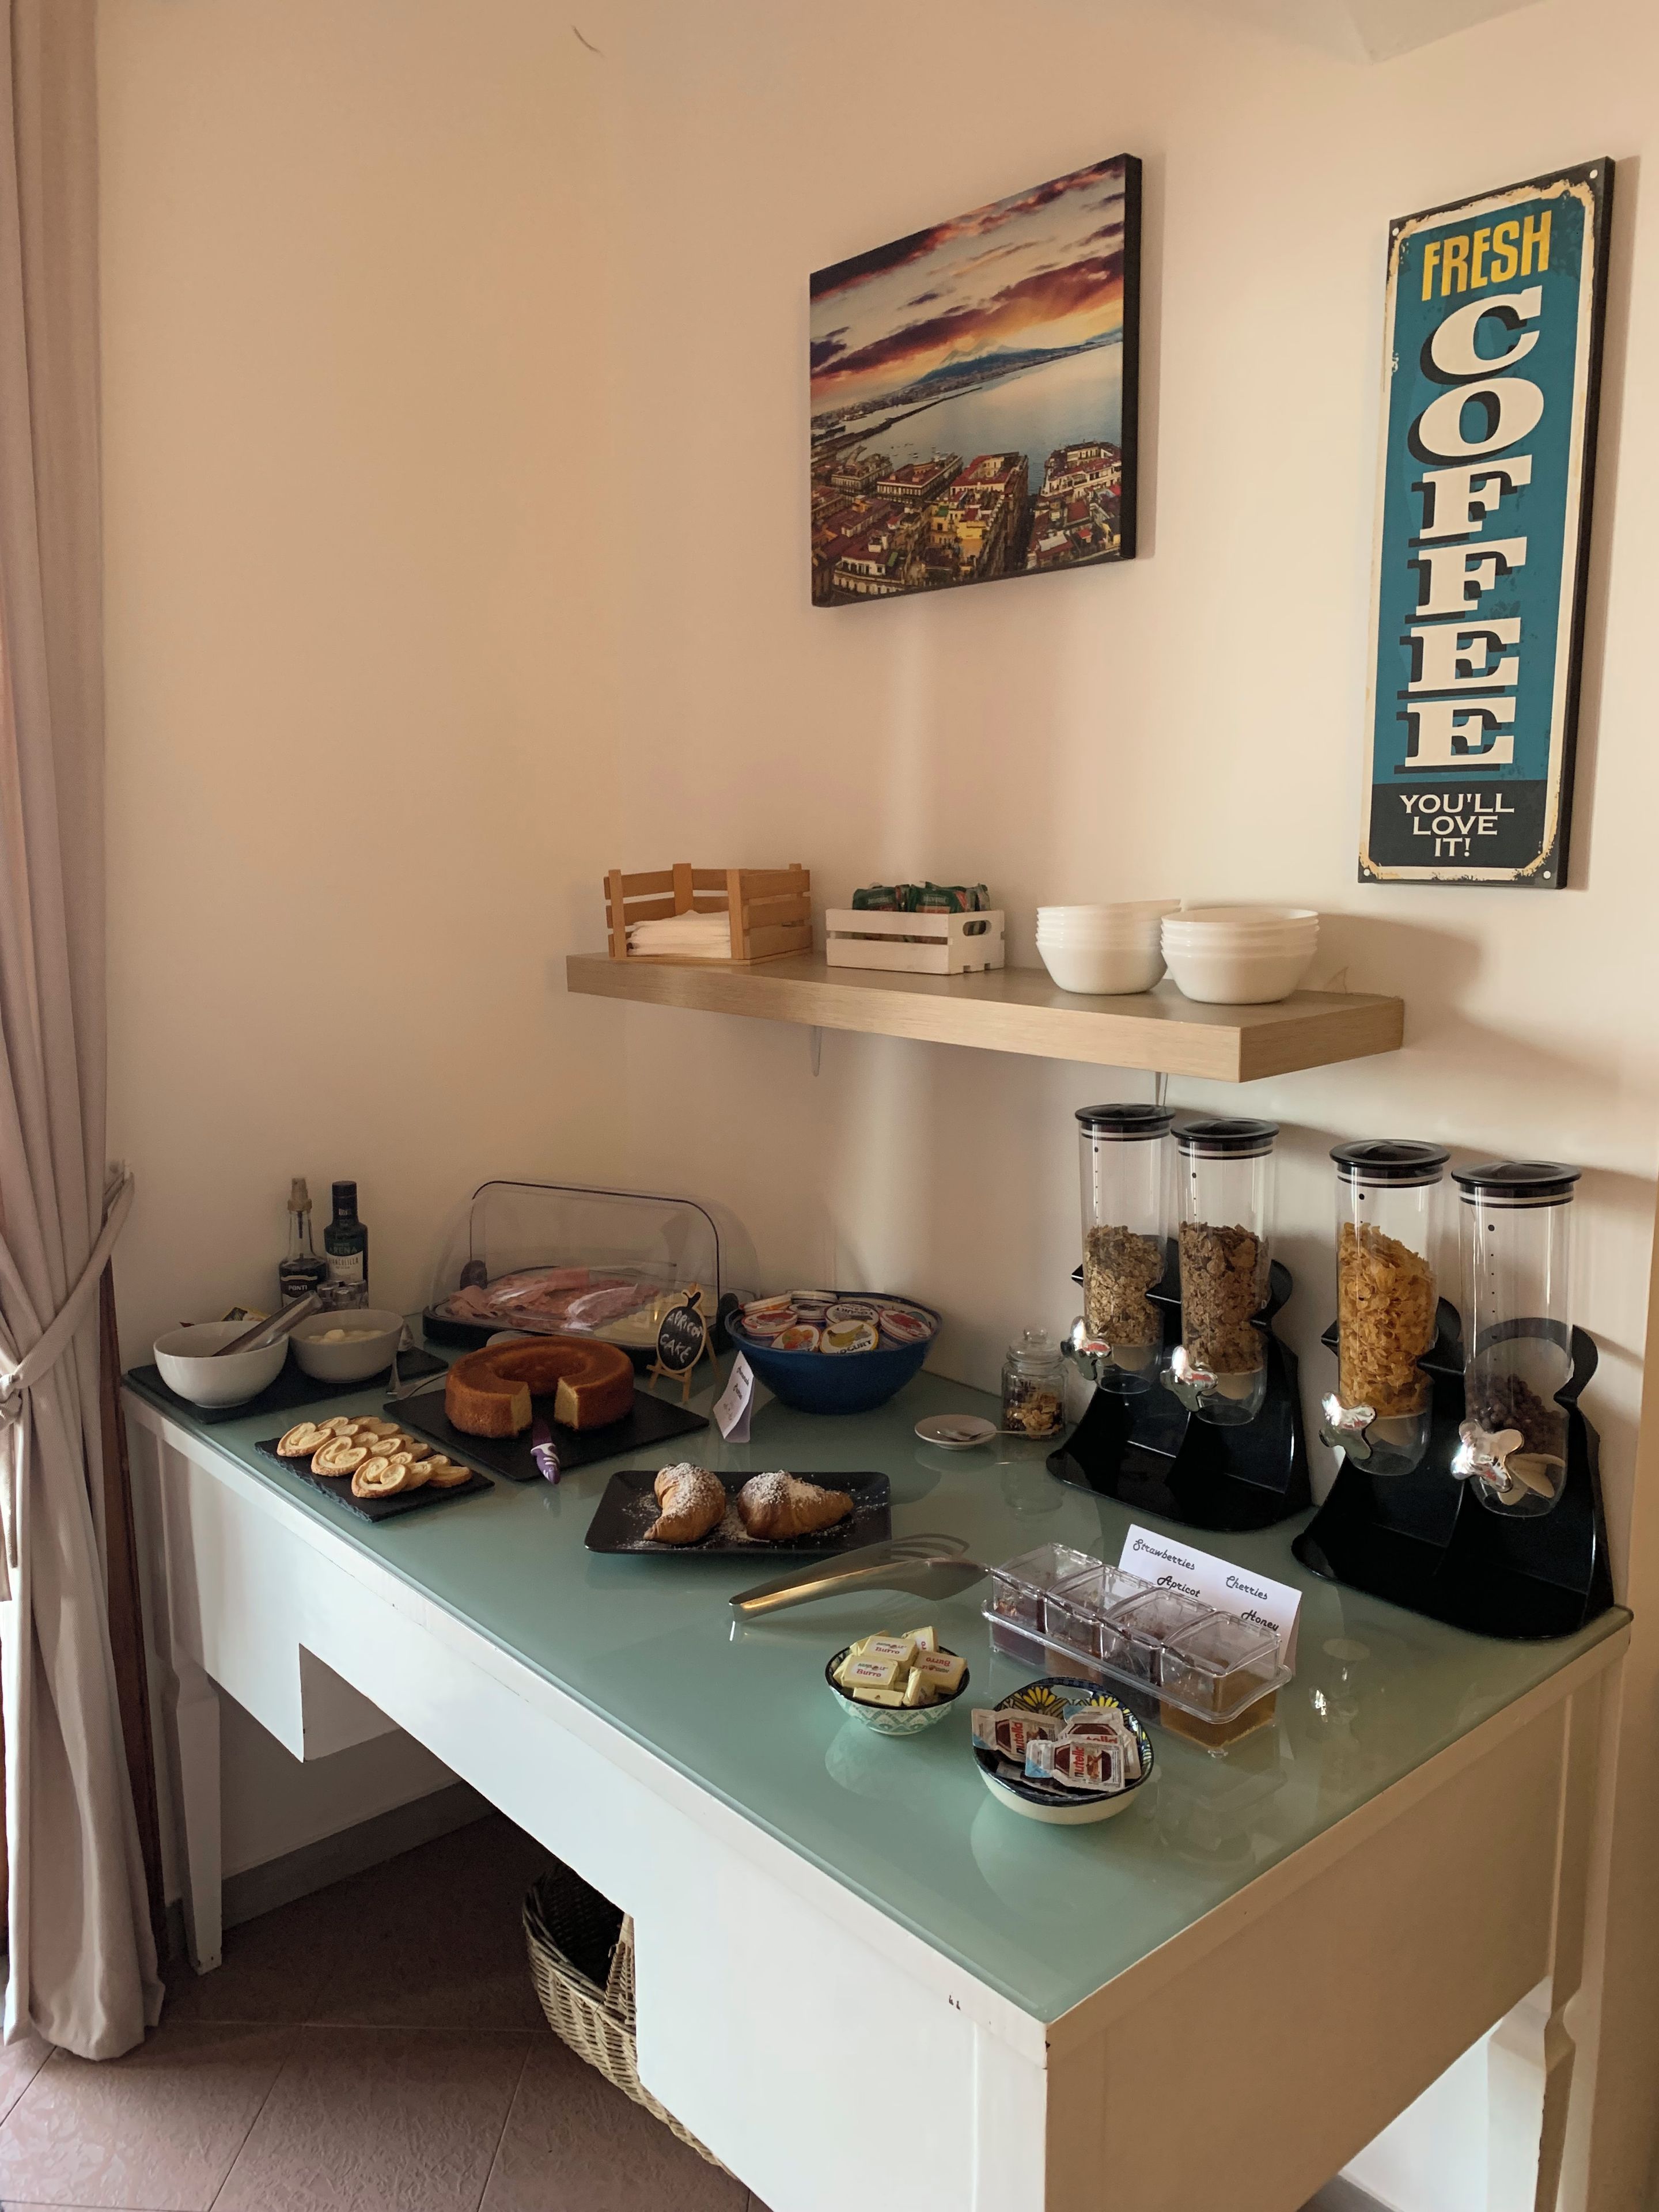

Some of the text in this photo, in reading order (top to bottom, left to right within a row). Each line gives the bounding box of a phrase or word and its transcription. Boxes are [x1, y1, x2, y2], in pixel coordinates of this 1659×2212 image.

[1421, 210, 1552, 301] FRESH
[1399, 285, 1545, 771] COFFEE
[1399, 793, 1515, 814] YOU'LL
[1412, 815, 1498, 836] LOVE
[1434, 837, 1471, 858] IT!
[328, 1246, 358, 1255] ARENA
[660, 1333, 692, 1363] CAKE
[836, 1339, 872, 1354] OGURT
[1132, 1539, 1195, 1570] Strawberries
[1157, 1575, 1201, 1598] Apricot
[1226, 1575, 1268, 1600] Cherries
[1241, 1609, 1279, 1632] Honey
[875, 1646, 900, 1655] Burro
[925, 1657, 951, 1667] Burro
[856, 1668, 882, 1677] Burro
[1011, 1721, 1025, 1755] nutella
[1071, 1746, 1085, 1778] nutella
